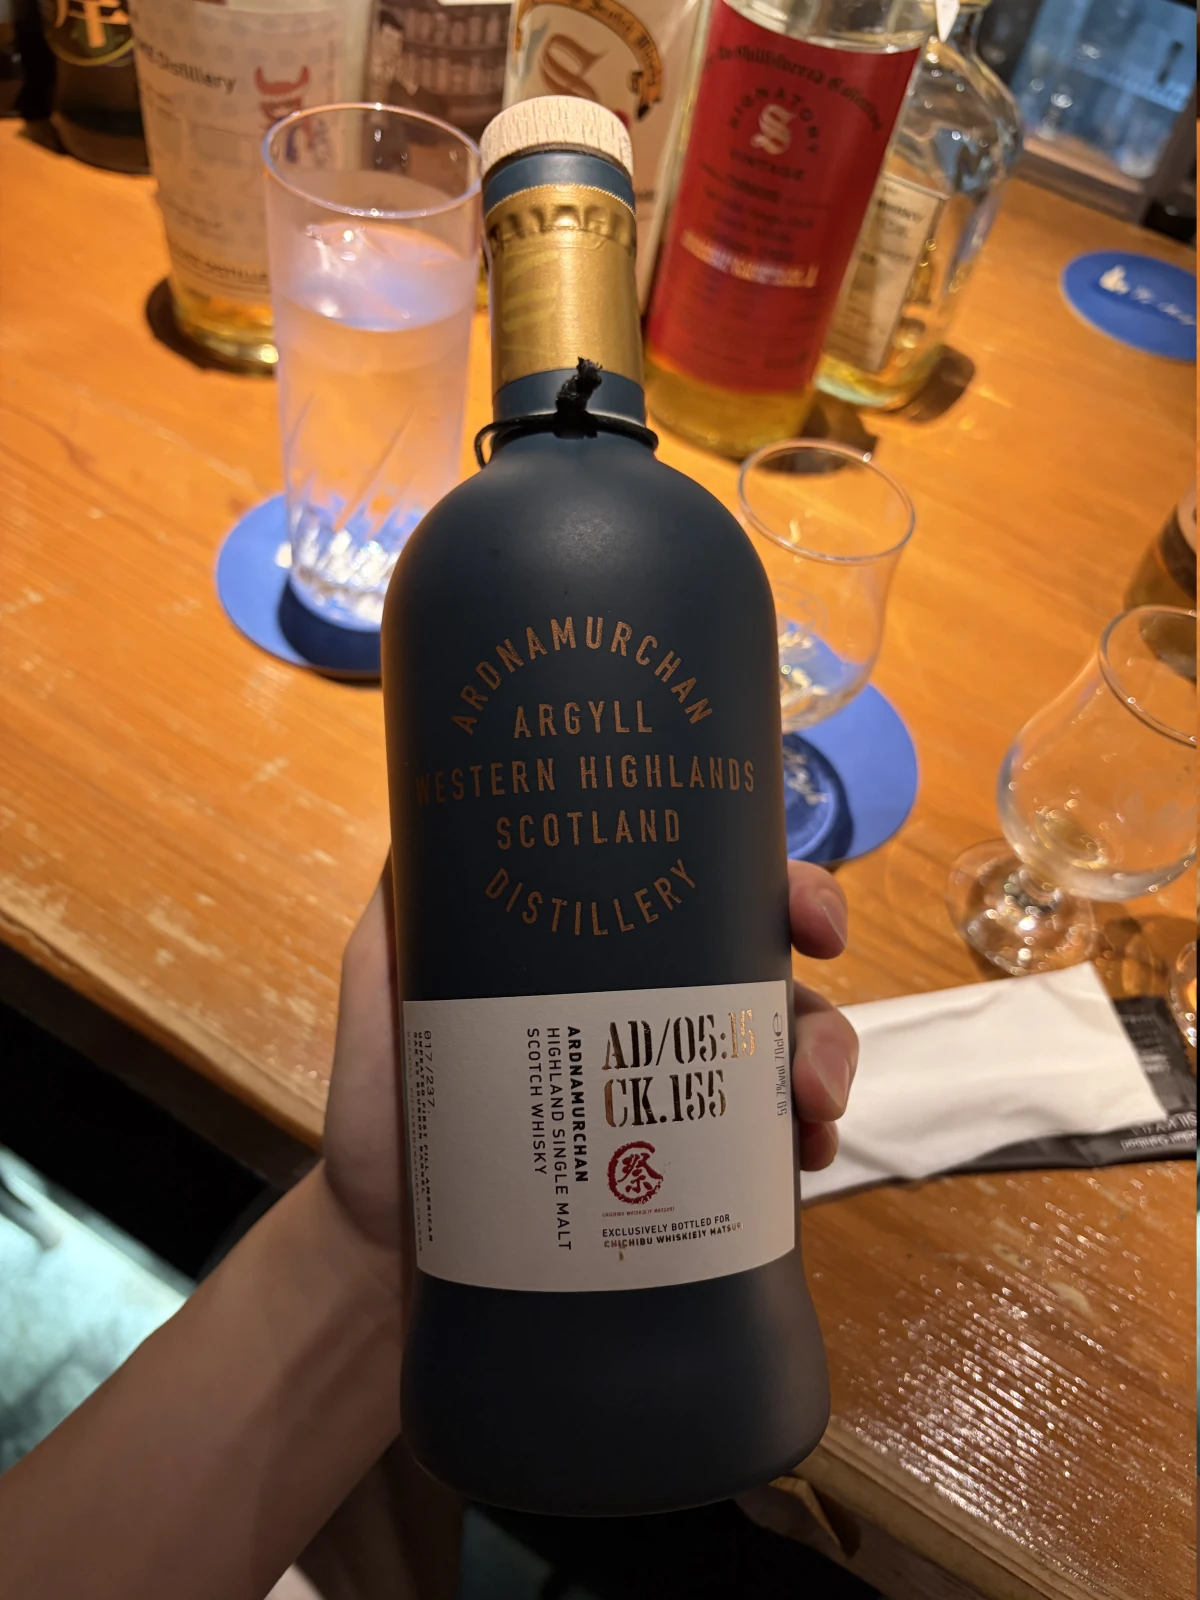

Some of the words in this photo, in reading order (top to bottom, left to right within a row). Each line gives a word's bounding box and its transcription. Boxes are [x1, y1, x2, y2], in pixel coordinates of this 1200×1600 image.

[452, 616, 712, 735] ARDNAMURCHAN
[514, 700, 652, 738] ARGYLL
[415, 758, 555, 805] WESTERN
[580, 754, 754, 792] HIGHLANDS
[496, 809, 680, 850] SCOTLAND
[485, 859, 696, 936] DISTILLERY
[527, 1027, 543, 1097] SCOTCH
[602, 1009, 755, 1071] AD/05:15
[547, 1027, 565, 1122] HIGHLAND
[567, 1025, 589, 1183] ARDNAMURCHAN
[603, 1069, 727, 1128] CK.155
[531, 1102, 547, 1176] WHISKY
[552, 1128, 569, 1196] SINGLE
[556, 1202, 572, 1251] MALT
[602, 1223, 668, 1238] EXCLUSIVELY
[671, 1217, 712, 1232] BOTTLED
[714, 1213, 730, 1225] FOR
[603, 1238, 653, 1249] CHICHIBU
